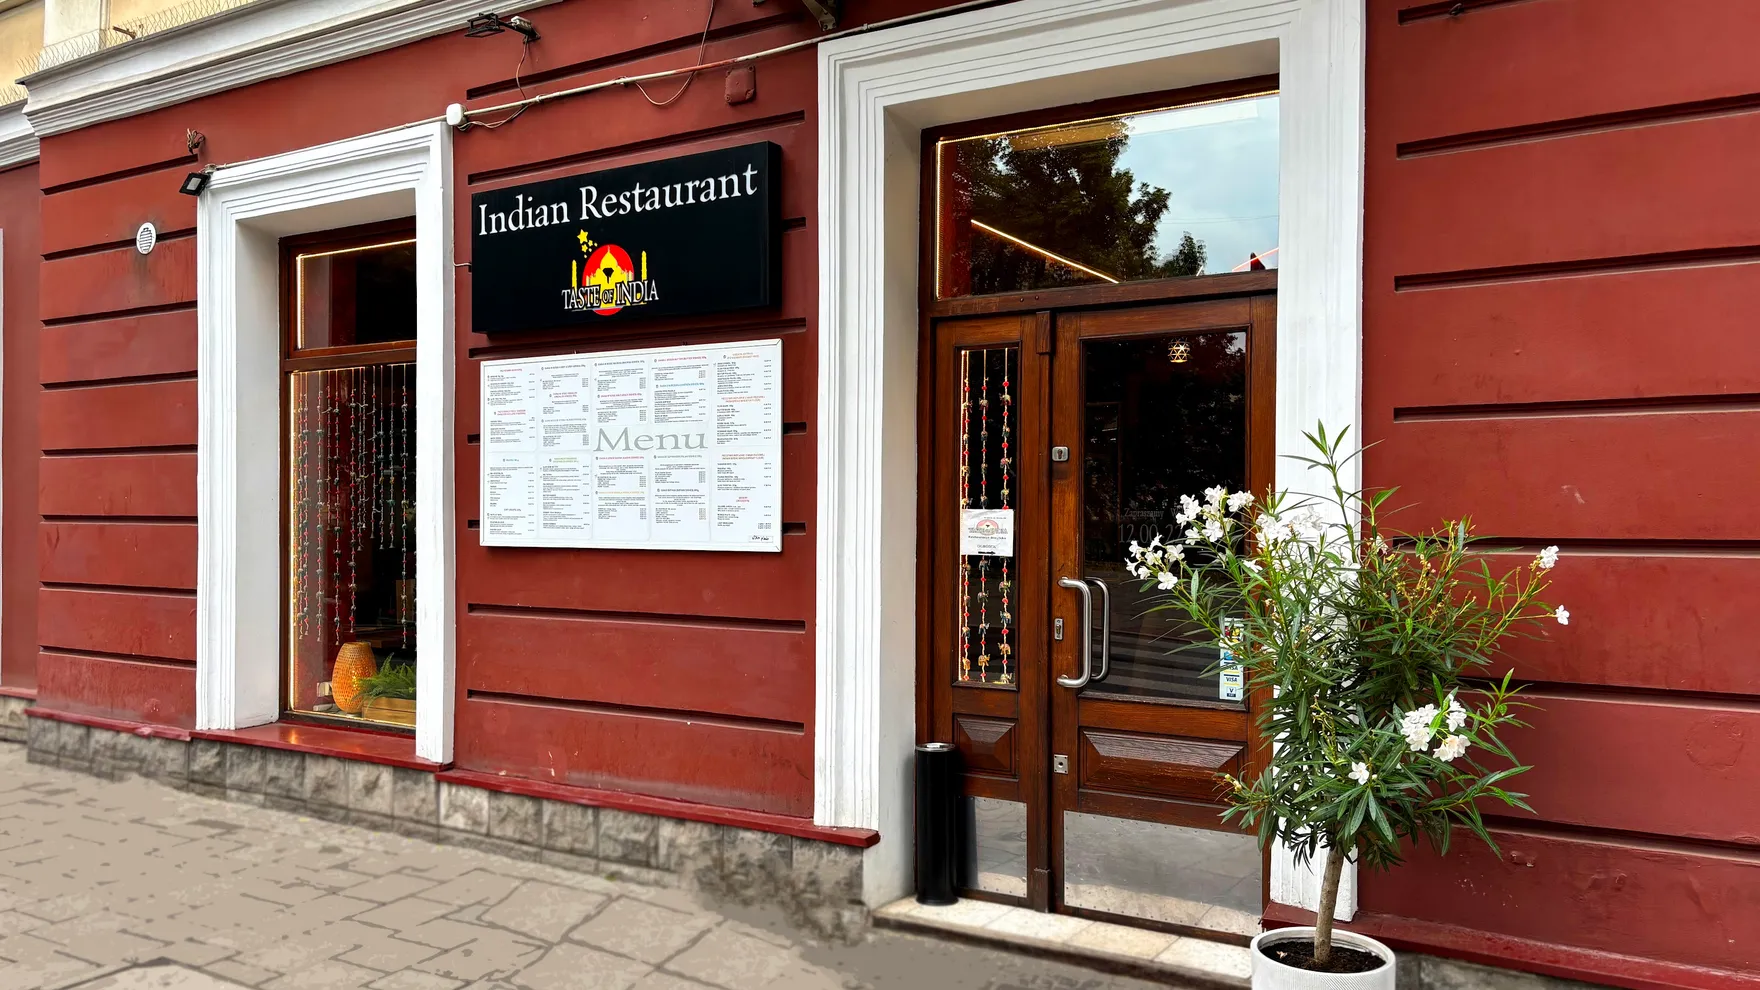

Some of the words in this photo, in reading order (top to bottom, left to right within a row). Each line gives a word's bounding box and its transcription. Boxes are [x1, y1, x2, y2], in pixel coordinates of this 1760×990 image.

[478, 193, 570, 236] Indian
[579, 163, 758, 221] Restaurant
[561, 286, 601, 310] TASTE
[602, 289, 614, 304] OF
[616, 279, 659, 305] INDIA
[593, 426, 708, 452] Menu
